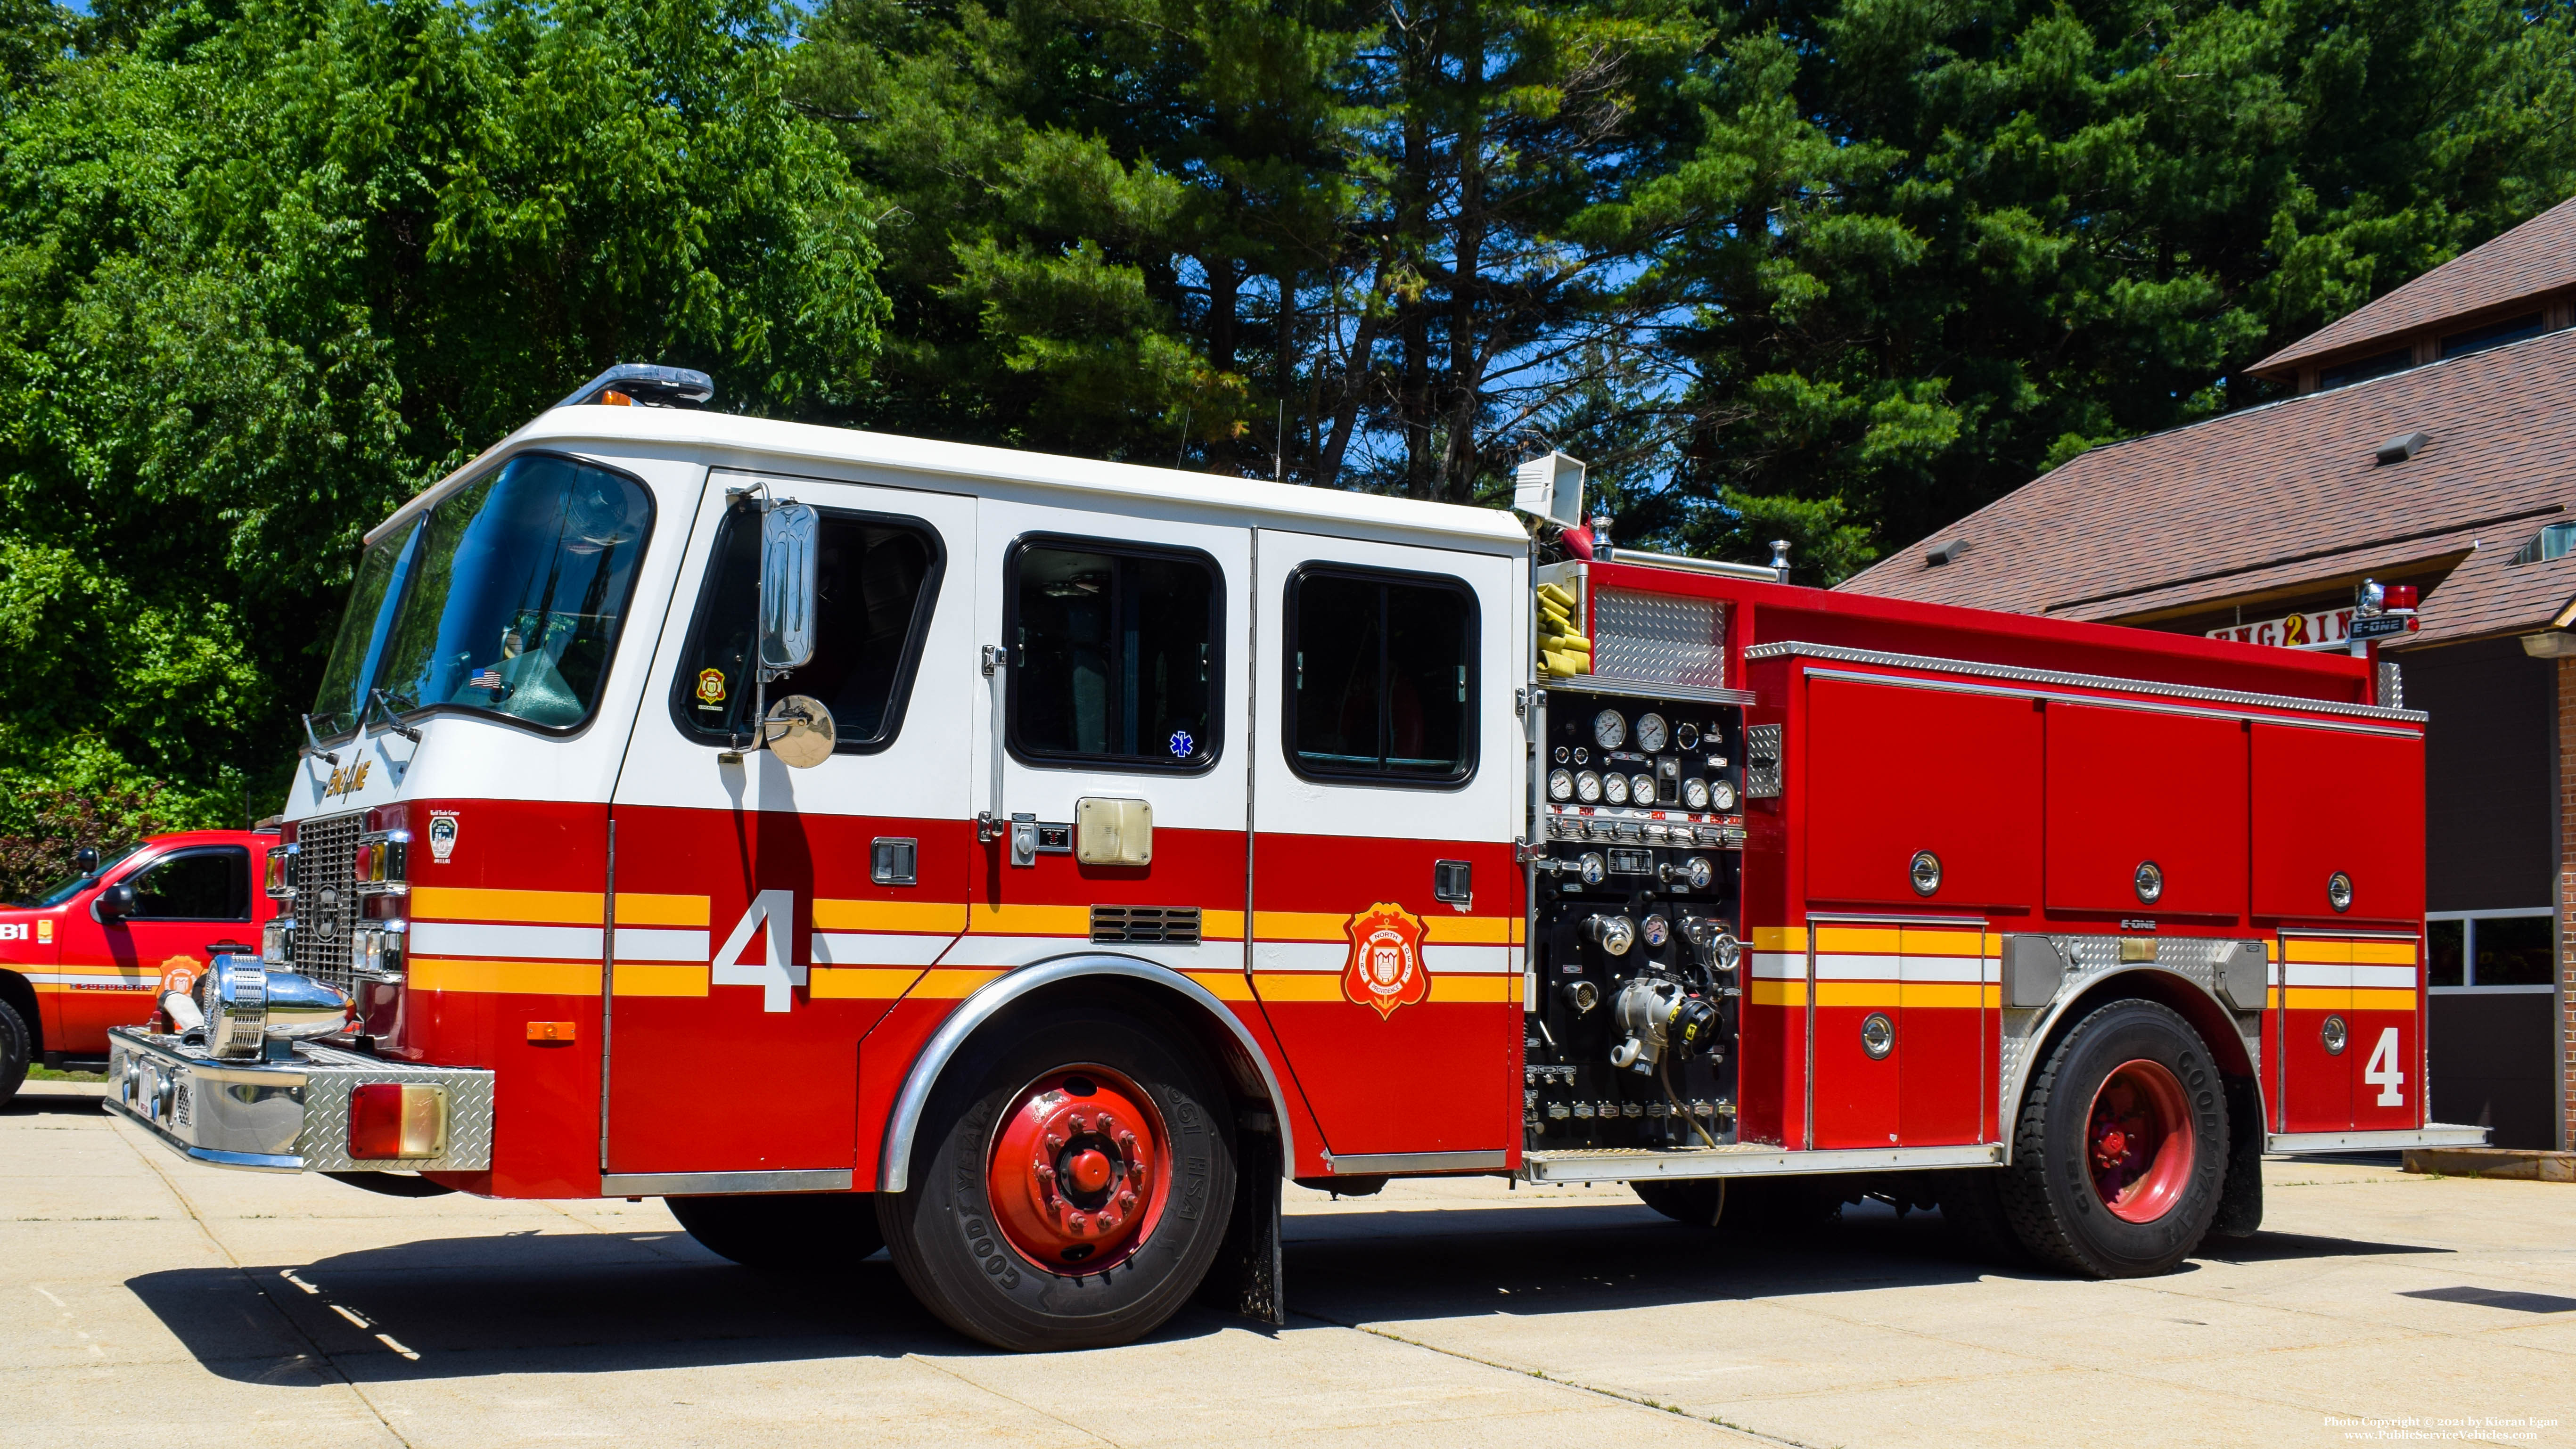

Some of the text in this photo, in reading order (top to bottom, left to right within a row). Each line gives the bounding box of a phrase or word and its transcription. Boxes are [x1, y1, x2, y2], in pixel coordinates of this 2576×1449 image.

[2353, 619, 2400, 633] E-ONE
[2287, 616, 2301, 646] 2
[1551, 805, 1562, 814] 75
[1579, 807, 1594, 816] 200
[1651, 811, 1665, 820] 200
[1689, 814, 1702, 822] 200
[2121, 920, 2157, 929] E-ONE
[712, 889, 807, 1012] 4
[1371, 984, 1400, 994] PROVIDENCE
[2365, 1028, 2404, 1106] 4
